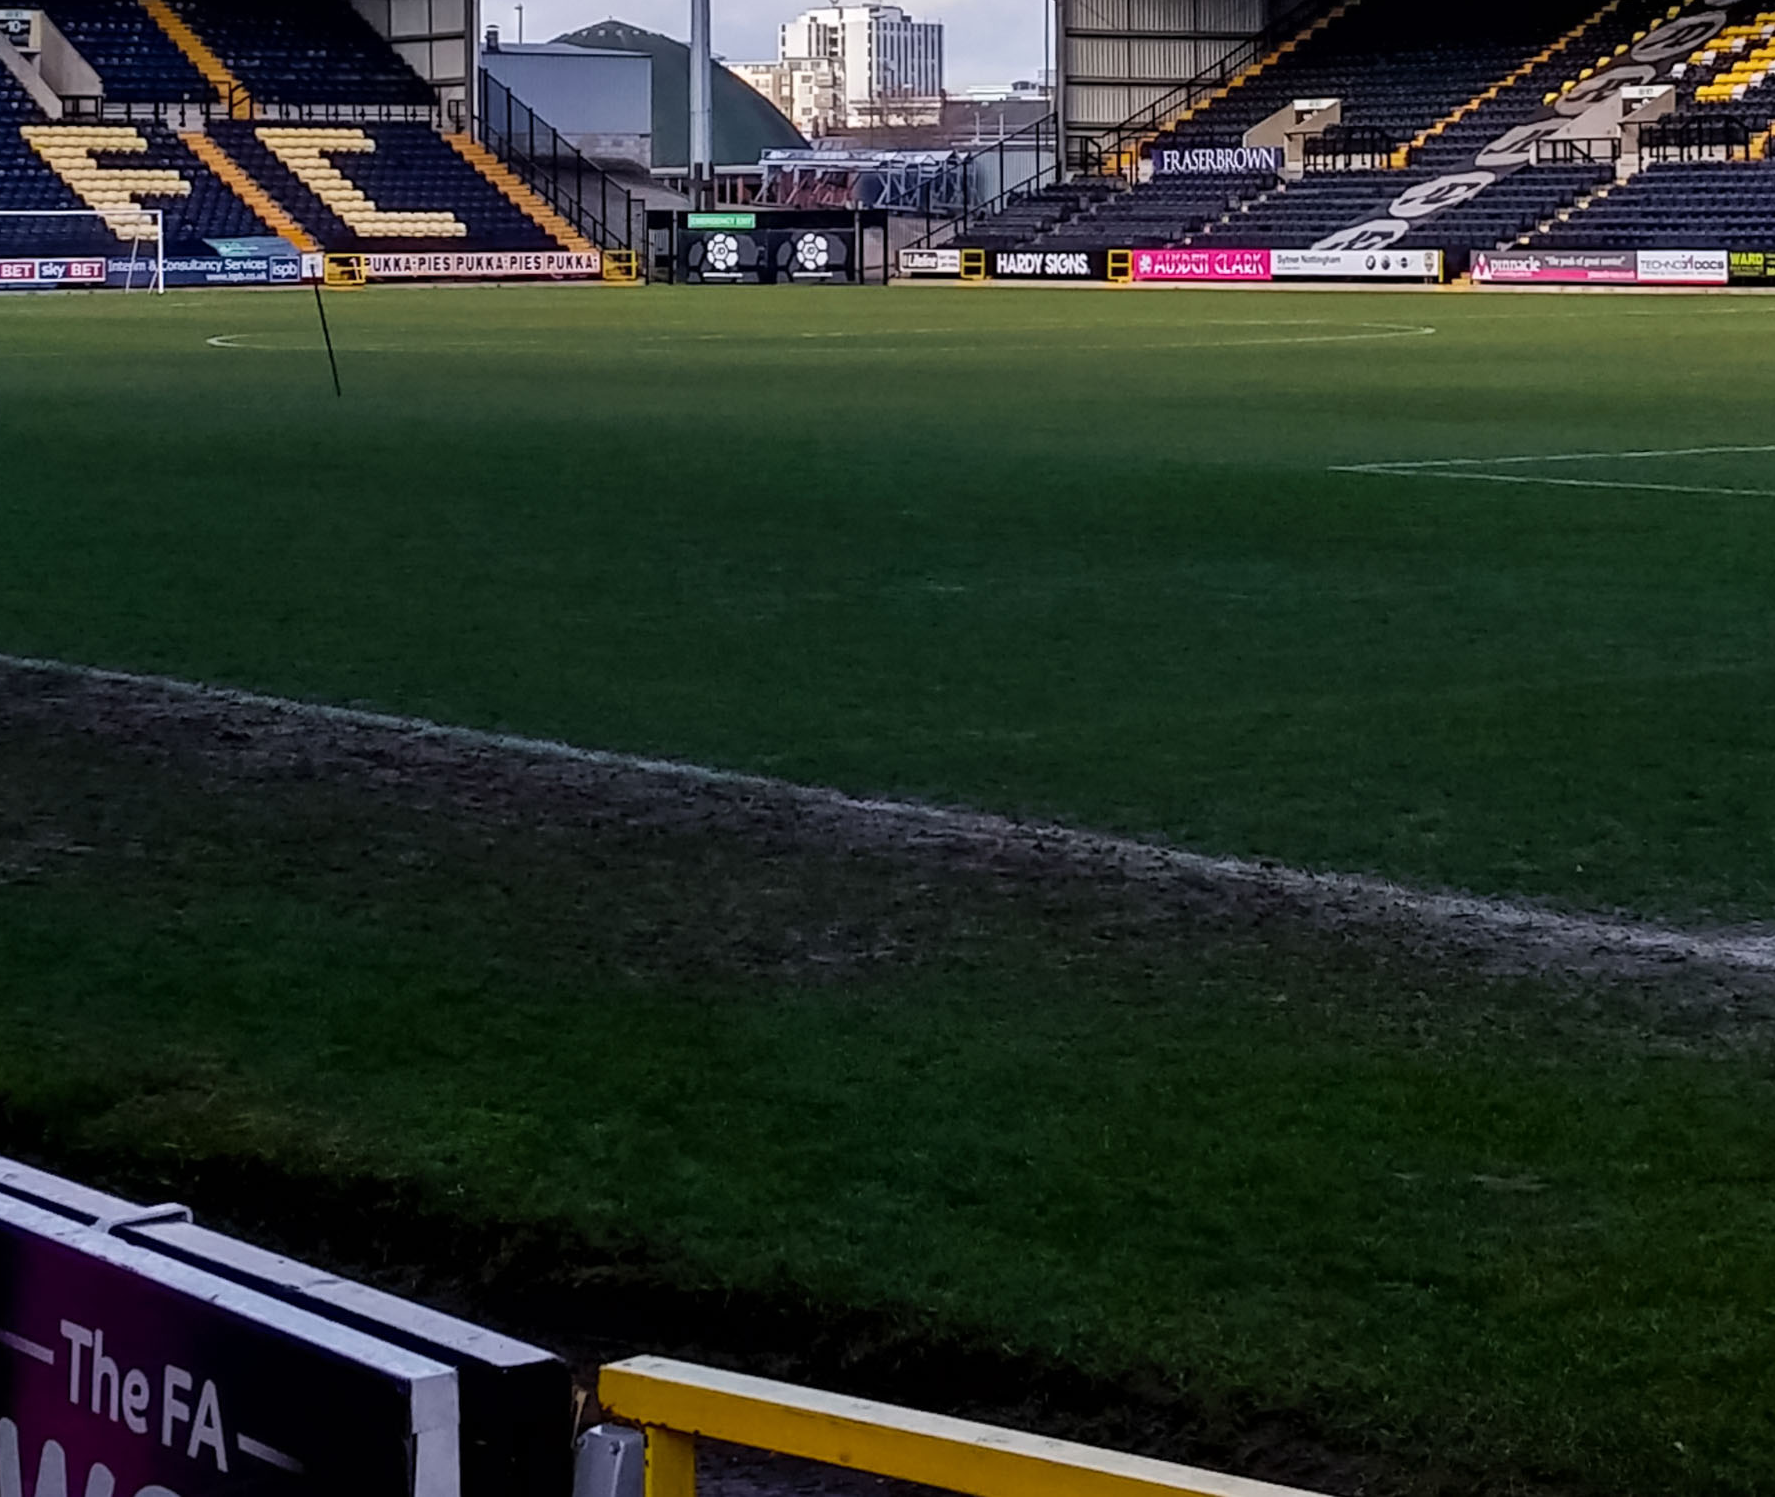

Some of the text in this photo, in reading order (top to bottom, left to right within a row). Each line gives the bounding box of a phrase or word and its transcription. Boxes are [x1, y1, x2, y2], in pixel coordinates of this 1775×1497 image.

[1163, 147, 1275, 171] FRASERBROWN
[162, 259, 223, 273] Consultancy
[224, 259, 268, 271] Services
[996, 253, 1043, 274] HARDY
[1214, 253, 1264, 275] CLARK
[1490, 255, 1541, 274] pinnacle
[1730, 252, 1764, 265] WARD
[0, 264, 32, 278] BET
[40, 262, 101, 280] sky BET
[272, 261, 298, 277] ispb
[60, 1316, 148, 1435] The
[160, 1361, 229, 1492] FA
